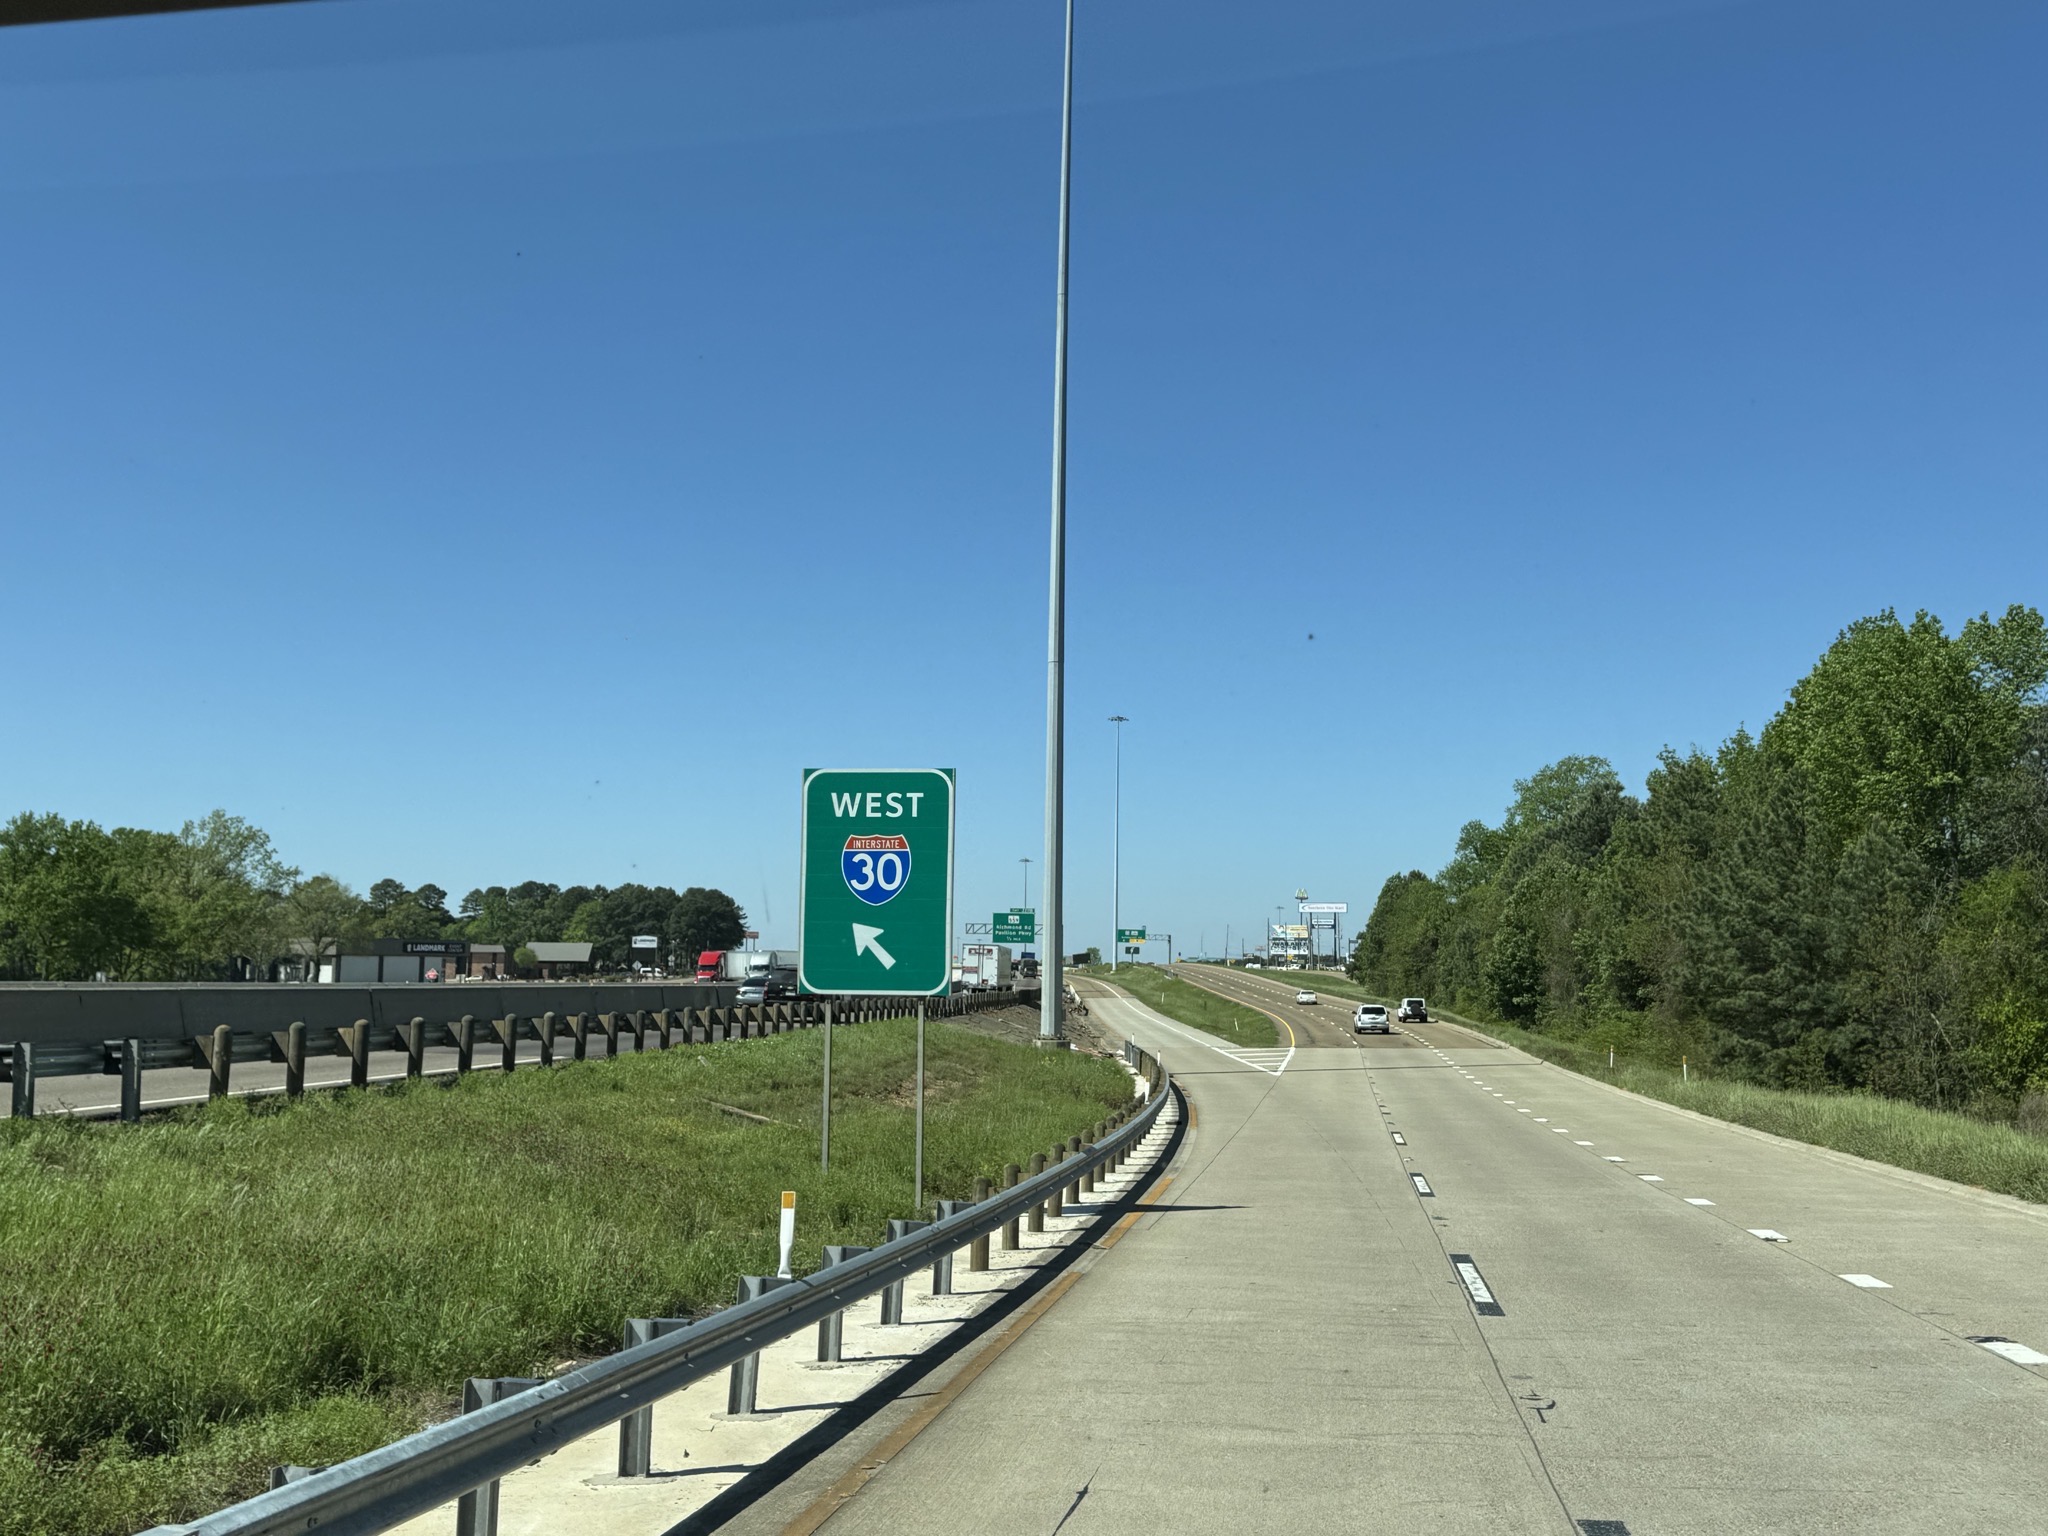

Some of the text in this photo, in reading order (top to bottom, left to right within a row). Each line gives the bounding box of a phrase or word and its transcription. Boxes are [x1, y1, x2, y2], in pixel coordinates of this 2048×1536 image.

[831, 792, 924, 818] WEST
[853, 839, 900, 849] INTERSTATE
[850, 853, 903, 891] 30
[413, 943, 446, 952] LANDMARK
